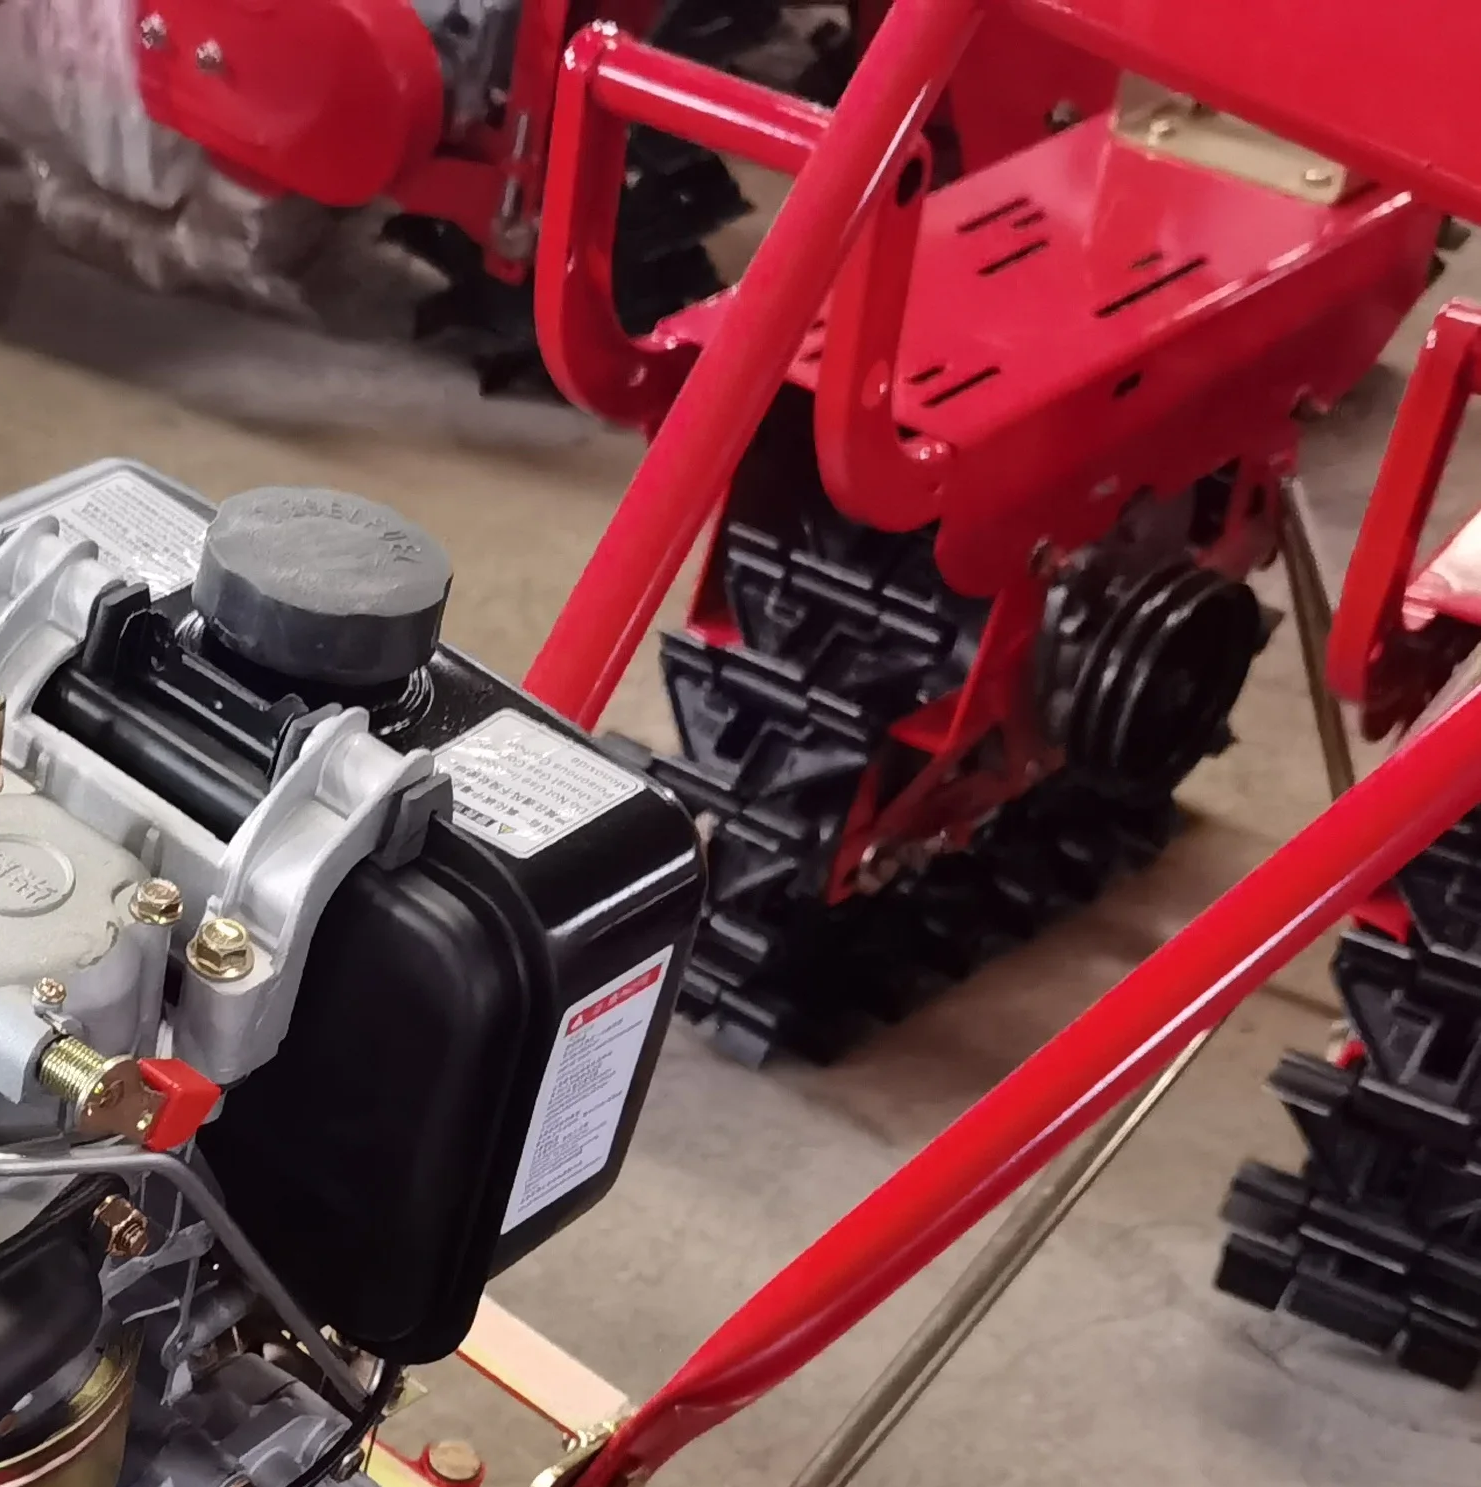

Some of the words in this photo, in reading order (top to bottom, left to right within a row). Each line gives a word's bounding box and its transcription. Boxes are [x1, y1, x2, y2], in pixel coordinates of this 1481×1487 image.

[517, 775, 548, 794] Use
[523, 763, 555, 783] Gas
[549, 761, 617, 800] Poisonous
[566, 755, 631, 792] Monoxide
[541, 788, 571, 805] Not
[548, 776, 603, 807] Exhaust
